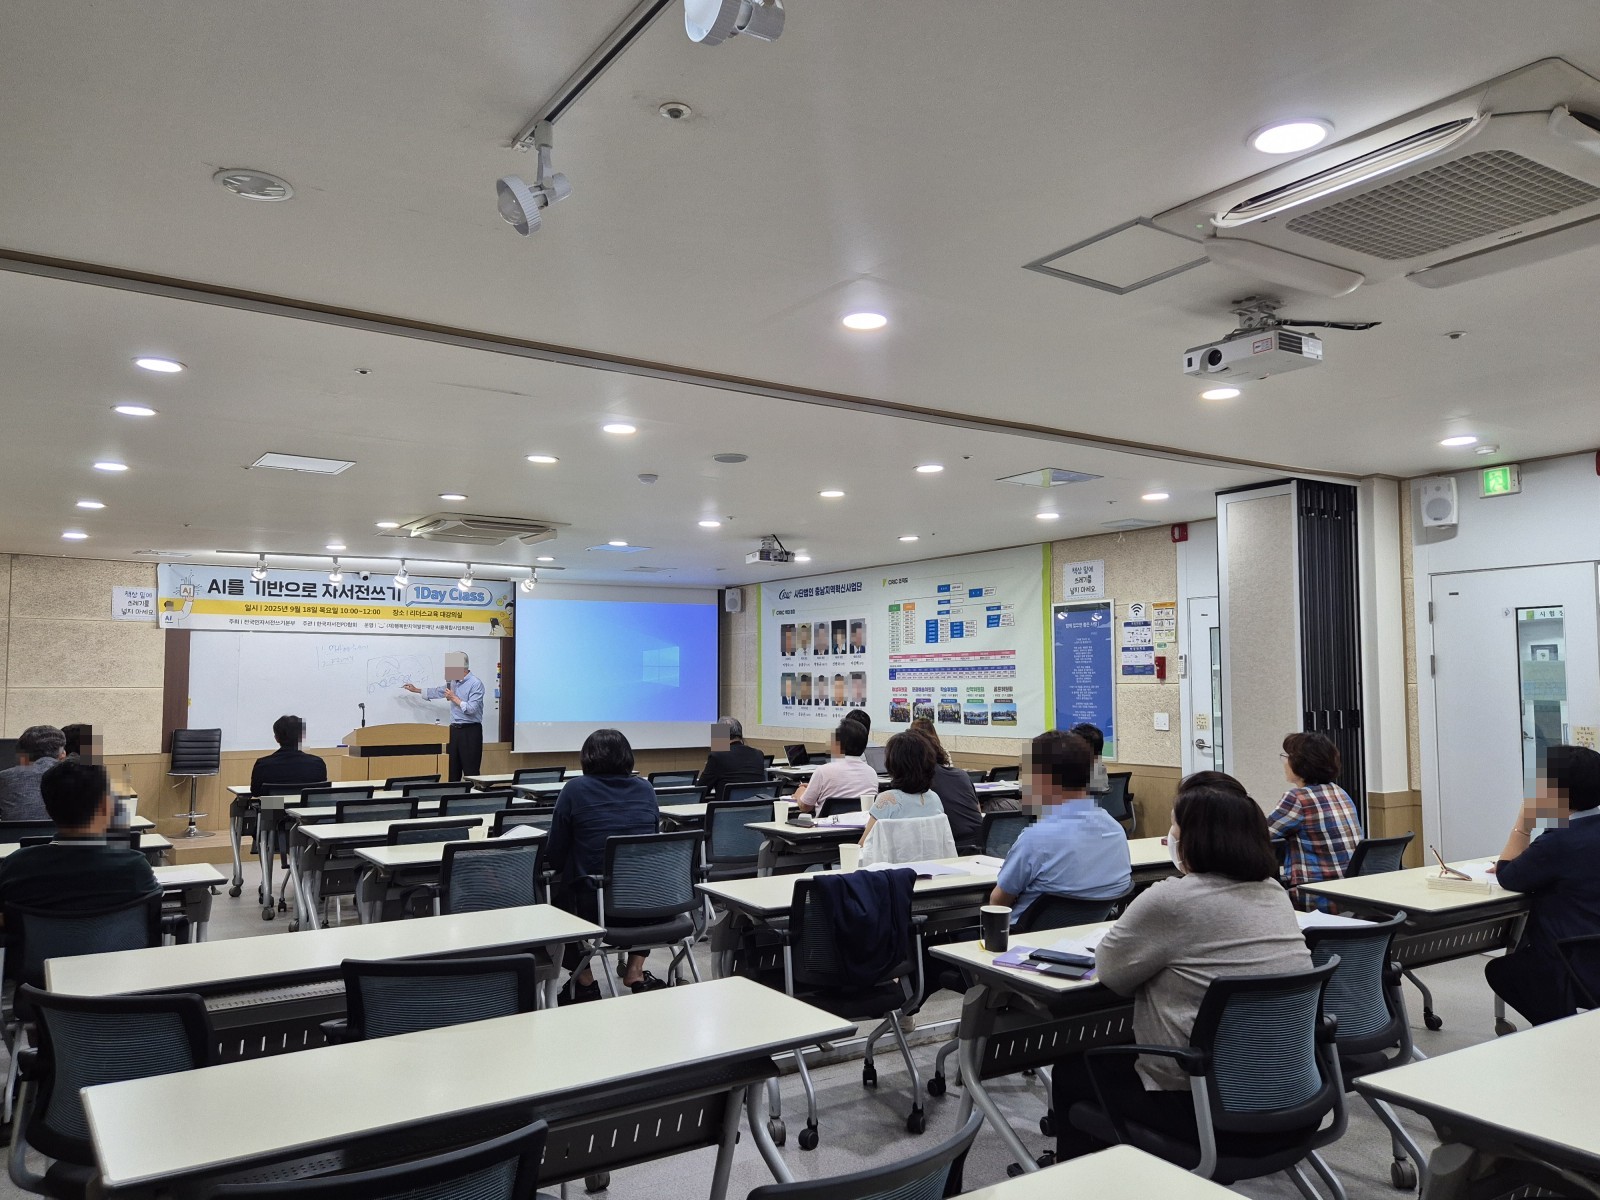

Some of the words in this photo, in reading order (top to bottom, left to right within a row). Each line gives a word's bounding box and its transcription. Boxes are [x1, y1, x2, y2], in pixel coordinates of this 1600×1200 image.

[124, 590, 138, 598] 책상
[208, 578, 244, 596] AI를
[250, 580, 318, 598] 기반으로
[322, 583, 400, 602] 자서전쓰기
[414, 586, 446, 603] 1Day
[449, 588, 484, 602] Class
[794, 588, 814, 598] 사단법인
[815, 582, 862, 596] 충남지역혁신사업단
[244, 604, 258, 612] 일시
[264, 604, 288, 613] 2025년
[289, 605, 300, 614] 9월
[319, 606, 338, 614] 목요일
[410, 610, 439, 618] 리더스교육
[440, 611, 463, 619] 대강의실
